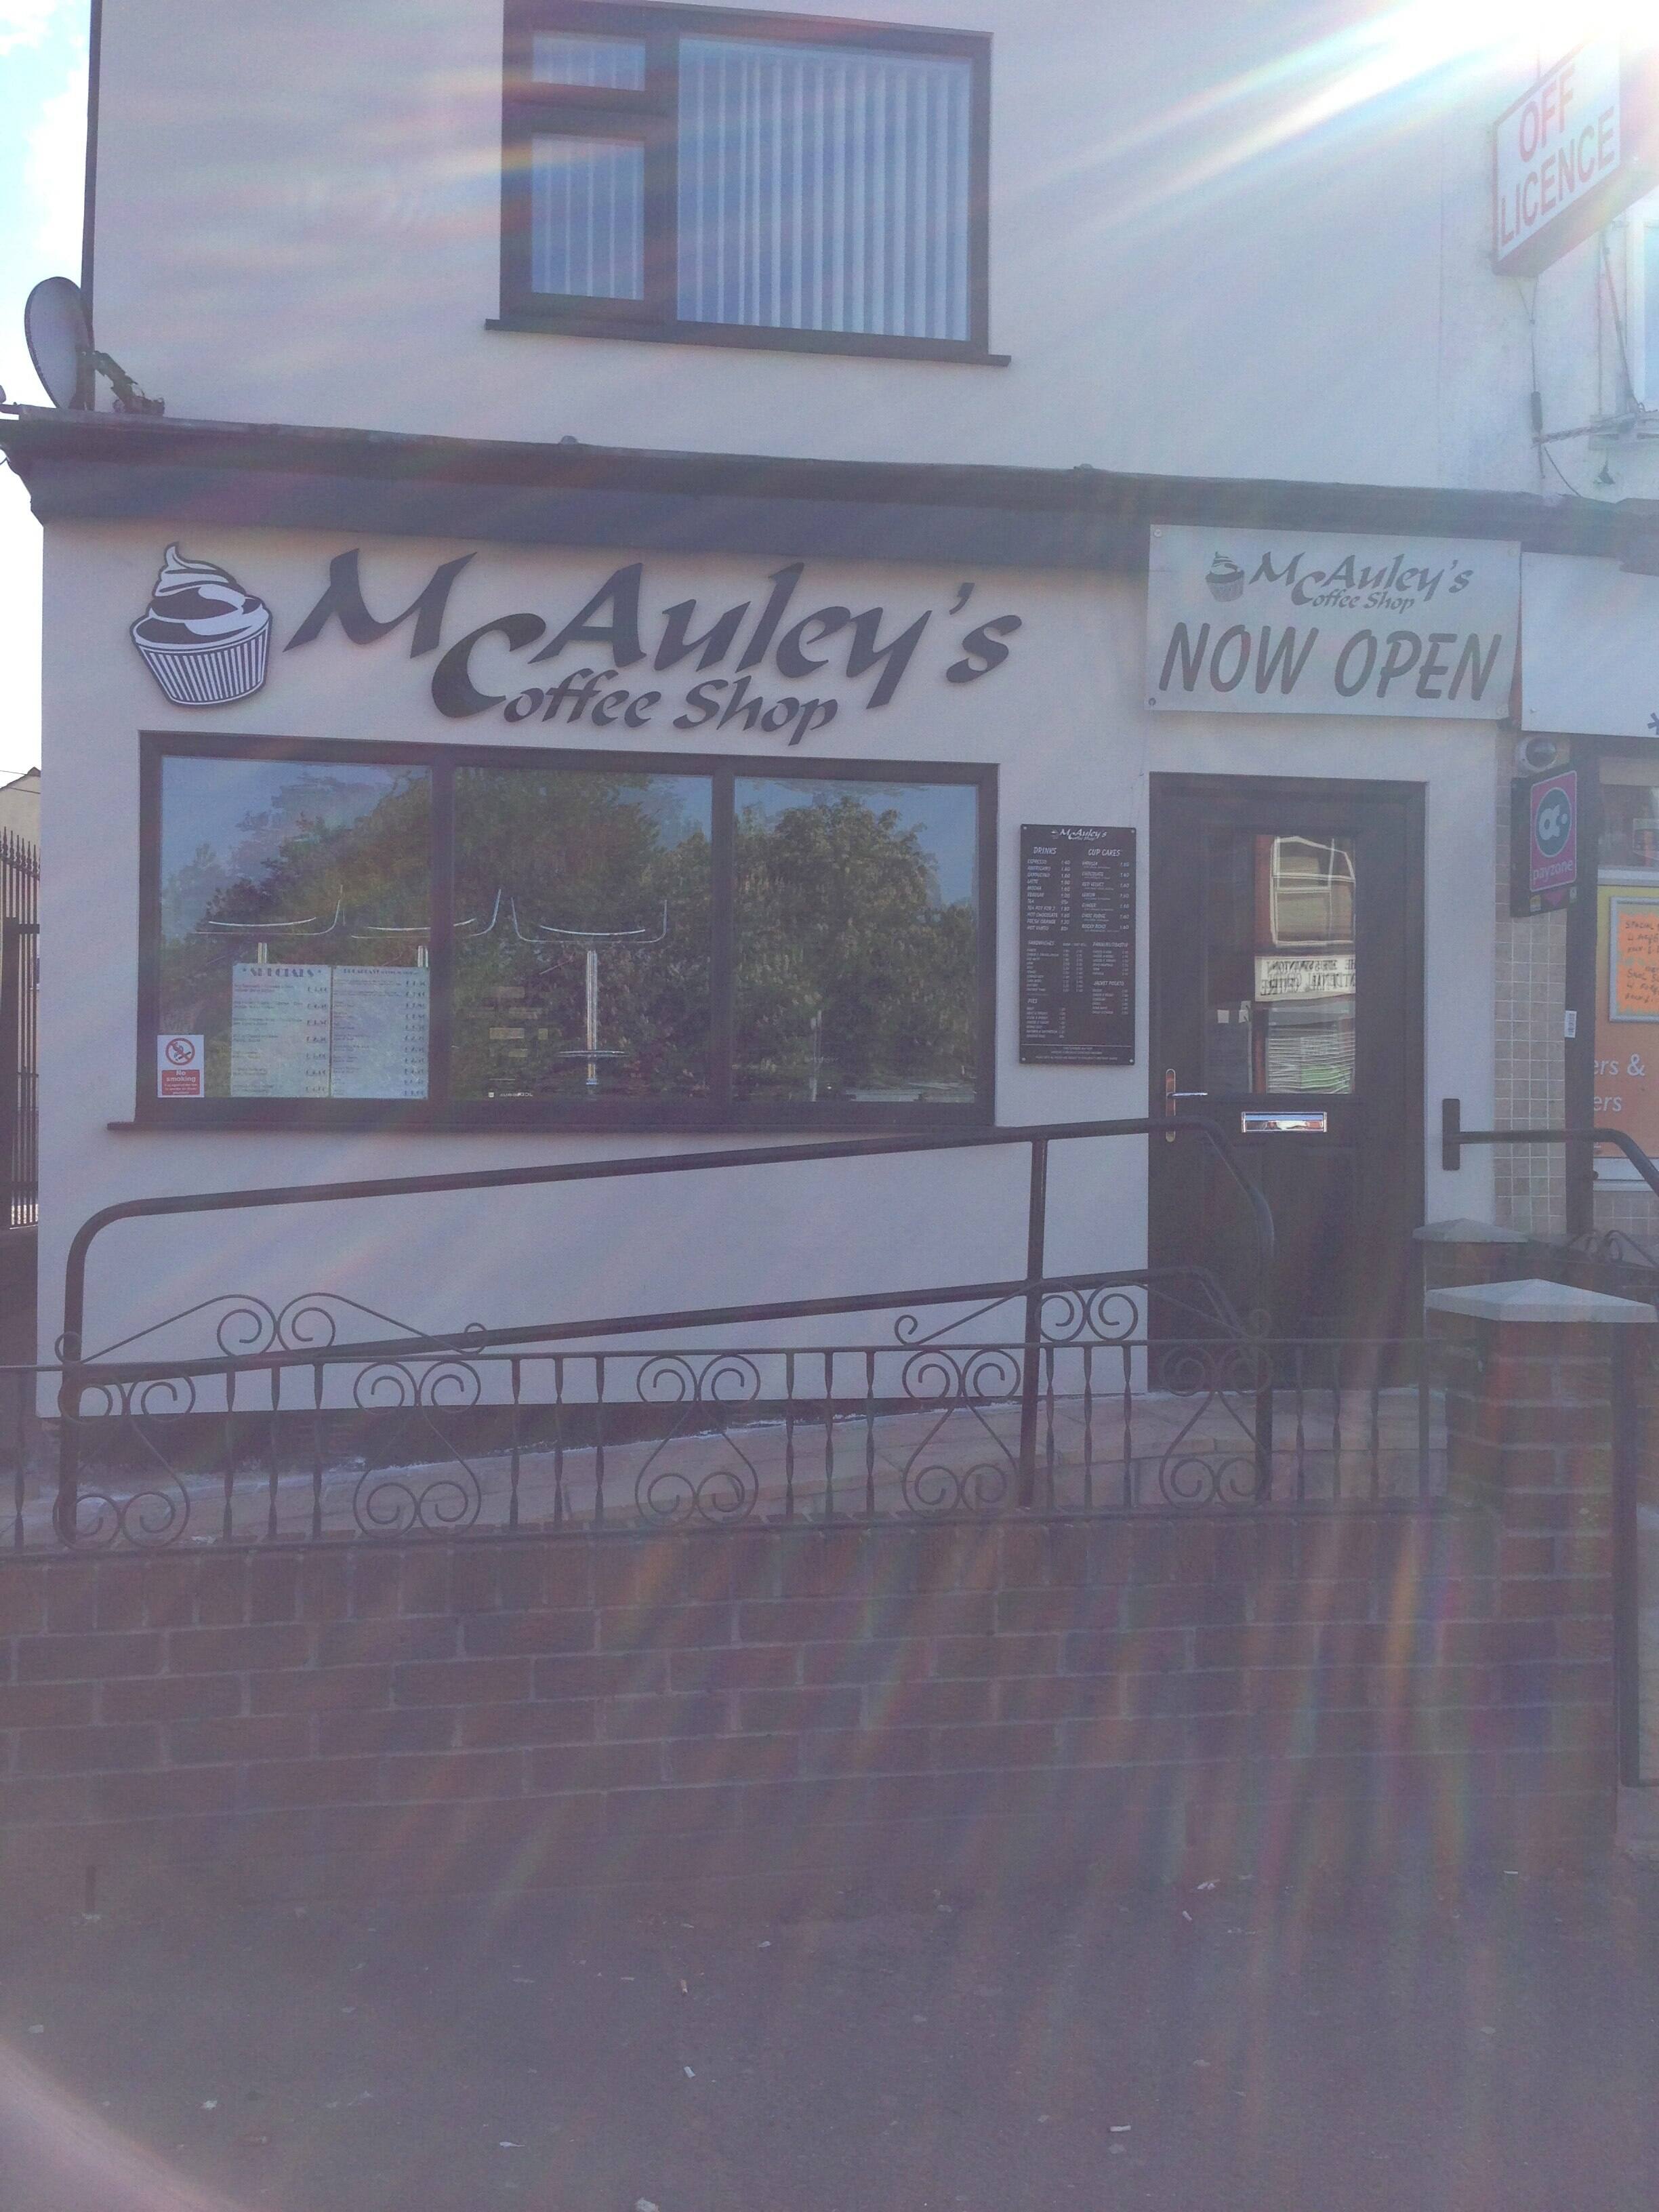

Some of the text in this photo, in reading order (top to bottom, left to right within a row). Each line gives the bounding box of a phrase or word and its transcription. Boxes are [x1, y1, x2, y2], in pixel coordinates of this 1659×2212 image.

[1519, 61, 1574, 162] OFF
[1500, 106, 1614, 247] LICENCE
[1364, 591, 1416, 614] Shop
[1158, 621, 1502, 701] NOW OPEN
[673, 675, 838, 746] Shop
[1033, 846, 1057, 855] DRINKS
[1088, 848, 1121, 857] CUP CAKES
[1533, 859, 1574, 886] payzone
[1627, 1053, 1646, 1077] &
